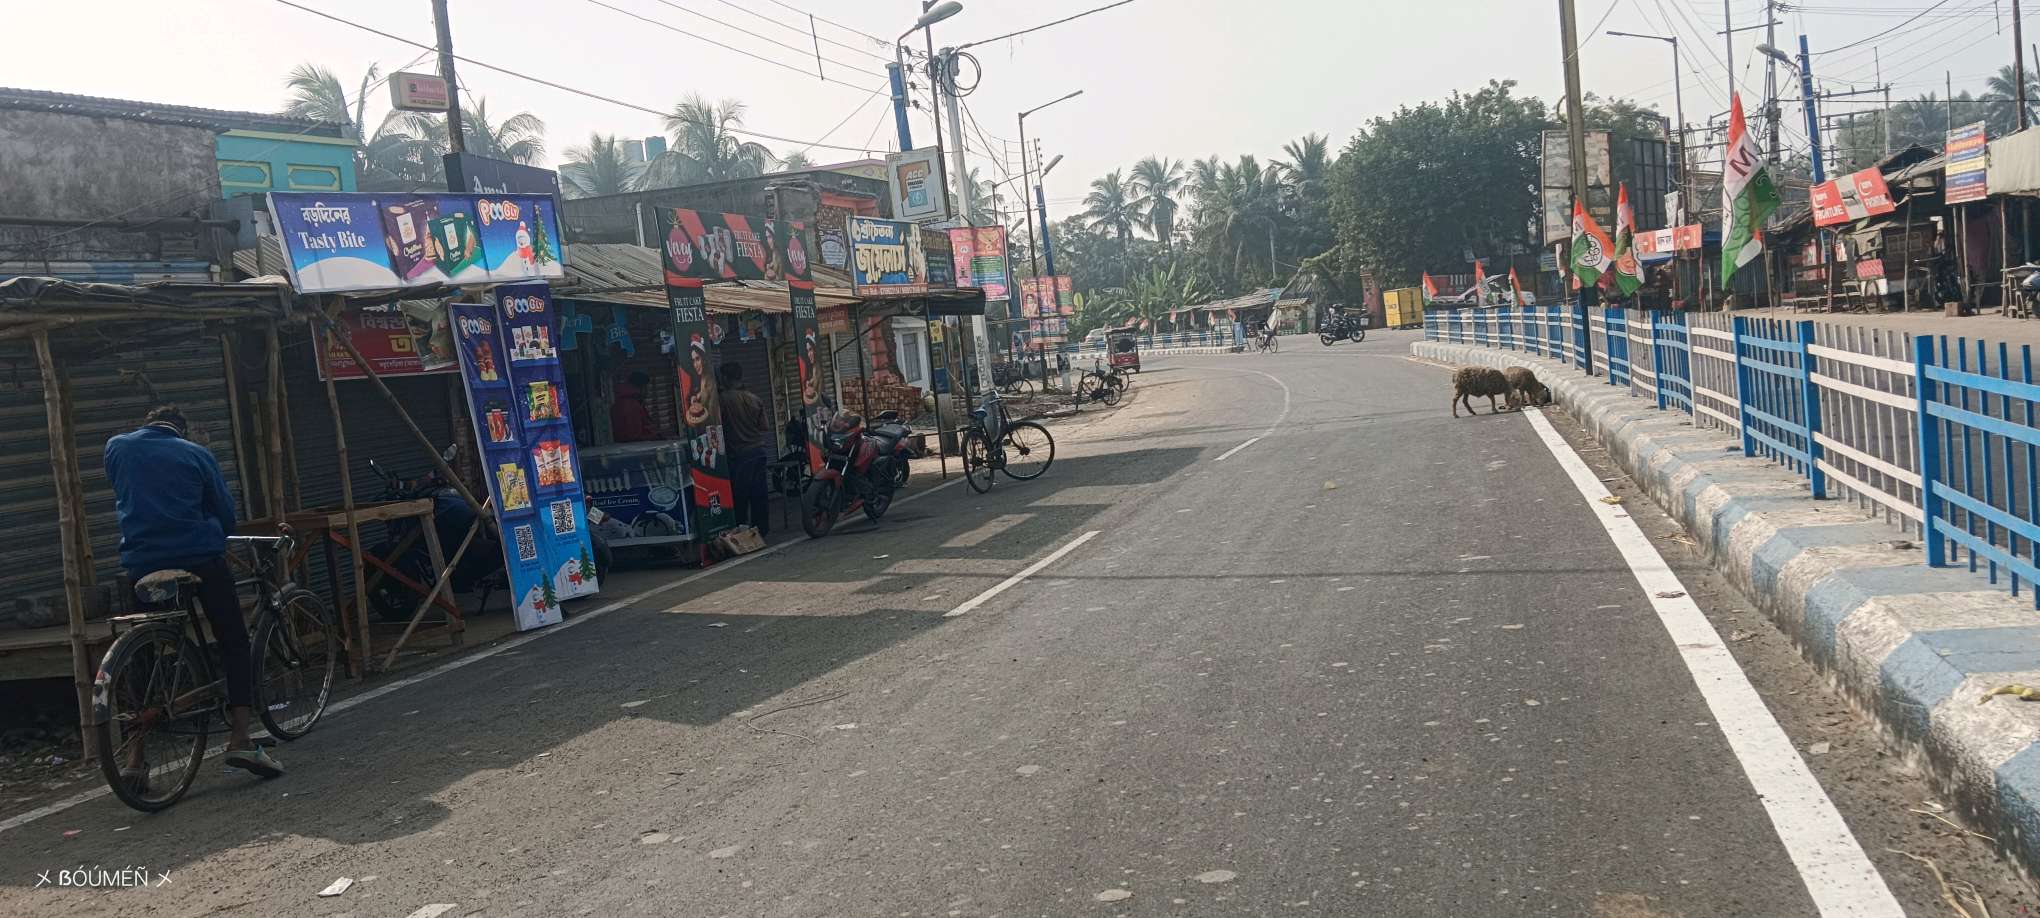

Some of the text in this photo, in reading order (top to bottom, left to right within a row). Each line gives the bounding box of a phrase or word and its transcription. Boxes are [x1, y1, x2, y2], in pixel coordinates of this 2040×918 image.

[301, 201, 352, 227] বড়দিনের
[298, 230, 367, 254] Tasty Bite
[736, 241, 764, 258] FIESTA
[676, 307, 704, 323] FIESTA
[795, 305, 815, 319] FIESTA
[585, 469, 631, 493] mul
